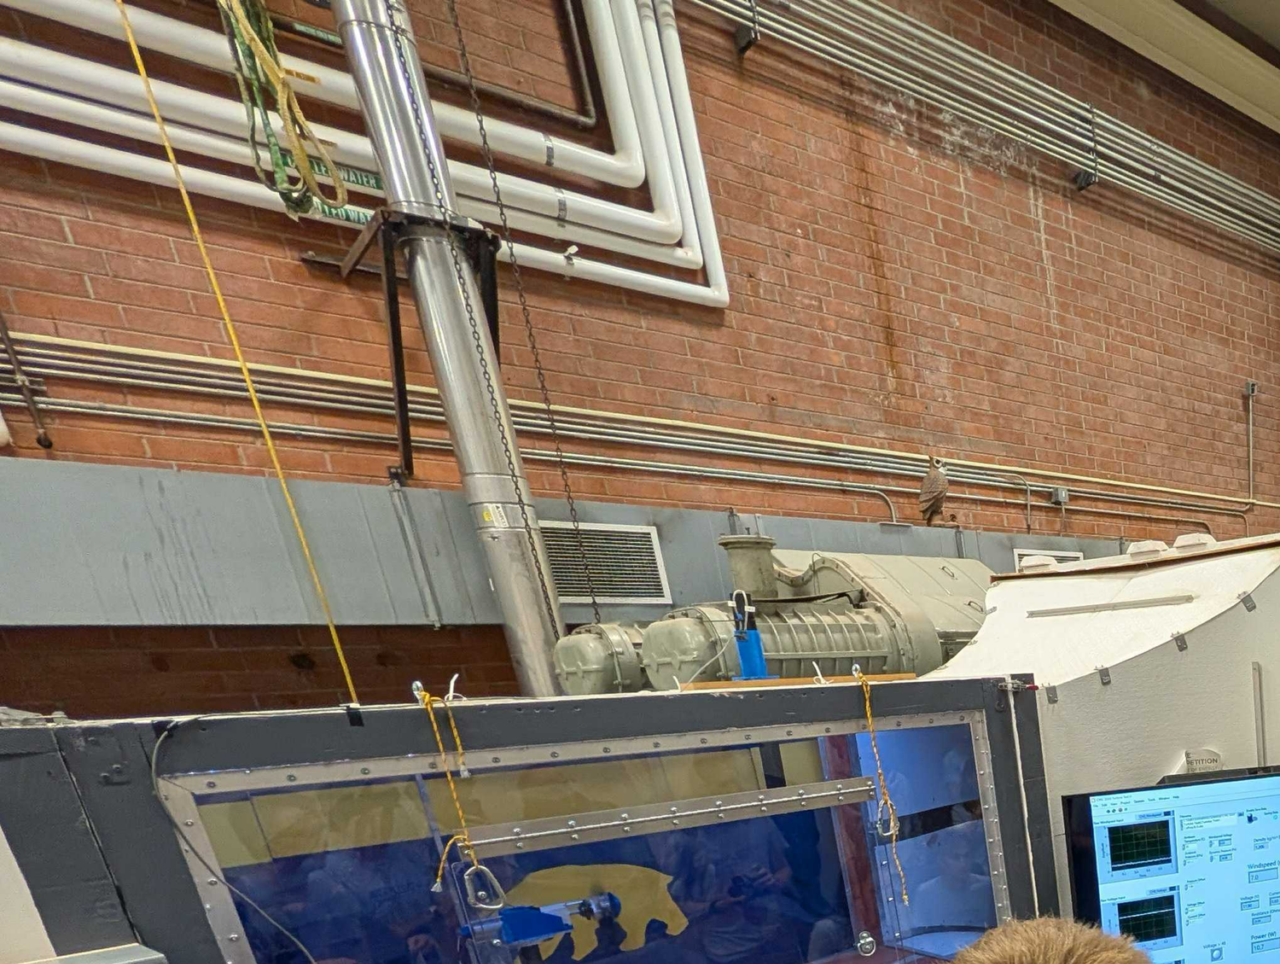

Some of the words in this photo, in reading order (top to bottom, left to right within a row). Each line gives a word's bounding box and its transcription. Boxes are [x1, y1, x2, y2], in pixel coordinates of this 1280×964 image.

[338, 168, 378, 190] WATER
[346, 208, 373, 224] WAT
[1247, 860, 1276, 870] Windspeed
[1251, 934, 1267, 942] Power
[1267, 930, 1277, 939] (W)
